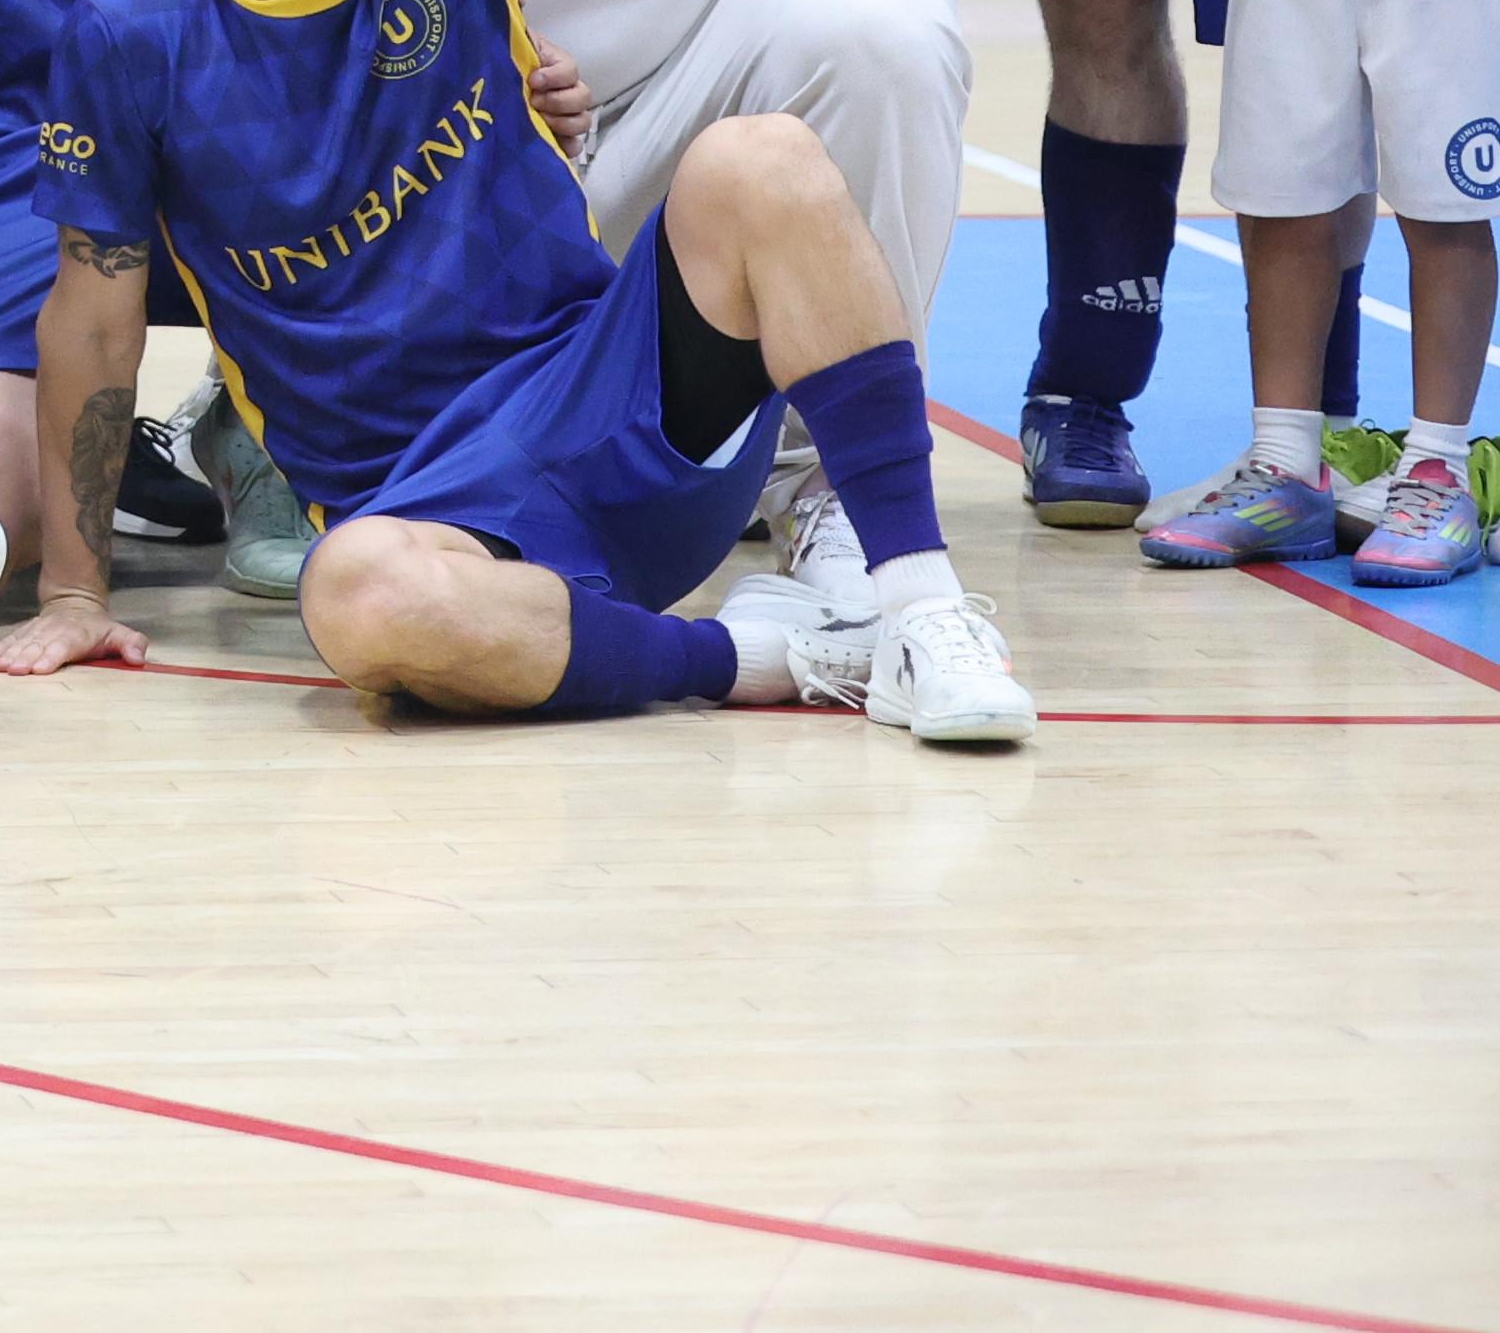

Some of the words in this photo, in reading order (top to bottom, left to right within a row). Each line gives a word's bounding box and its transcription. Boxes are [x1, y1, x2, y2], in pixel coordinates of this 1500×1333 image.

[383, 8, 414, 44] U
[1474, 144, 1494, 173] U
[224, 78, 494, 292] UNIBANK
[1082, 293, 1161, 314] adida
